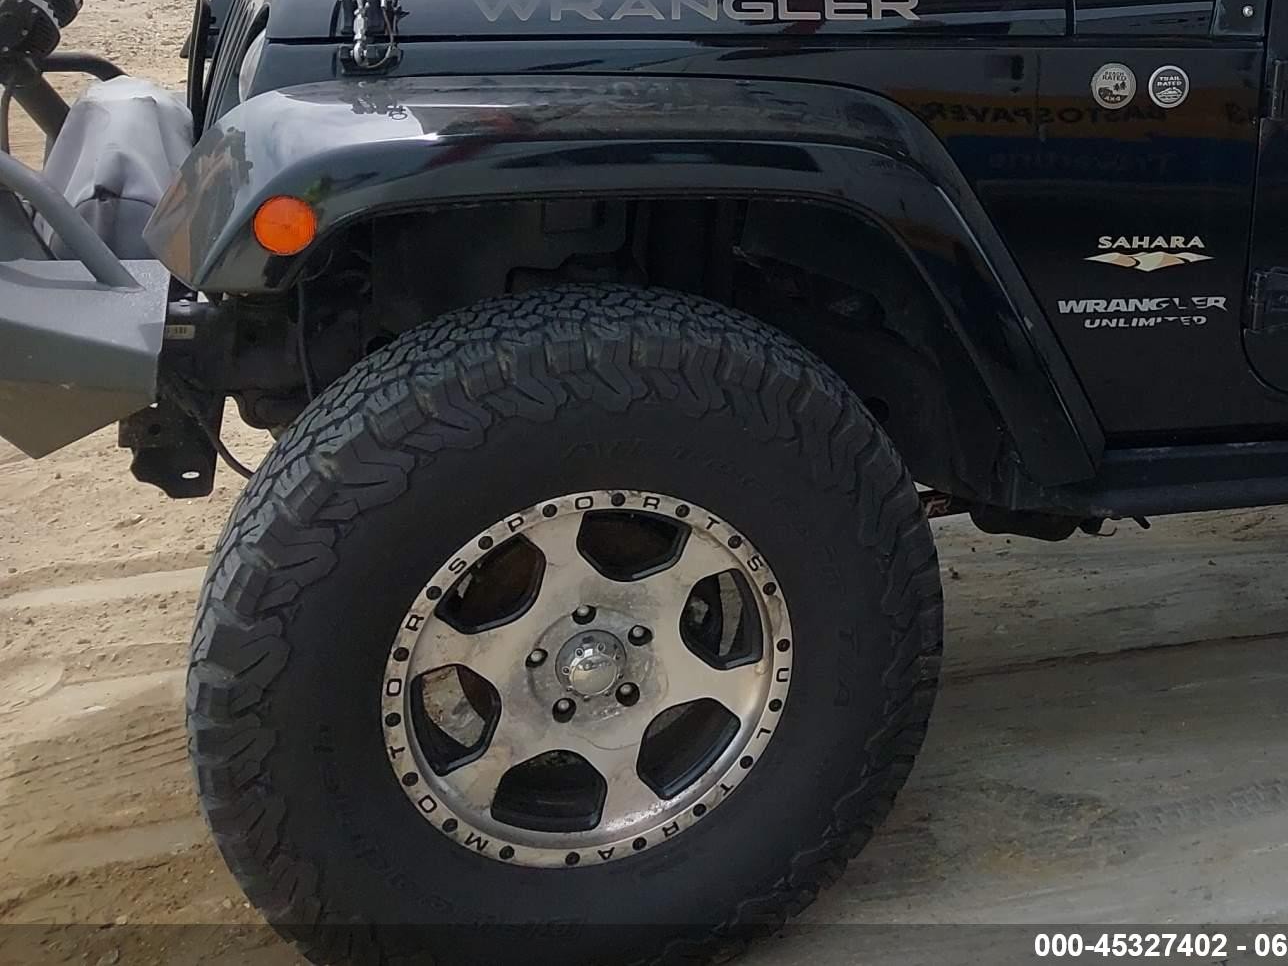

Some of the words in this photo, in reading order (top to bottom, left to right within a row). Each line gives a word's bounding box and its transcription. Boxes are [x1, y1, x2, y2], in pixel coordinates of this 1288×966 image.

[1097, 235, 1205, 249] SAHARA
[385, 493, 764, 853] MOTORSPORTS
[597, 665, 791, 863] ULTRA
